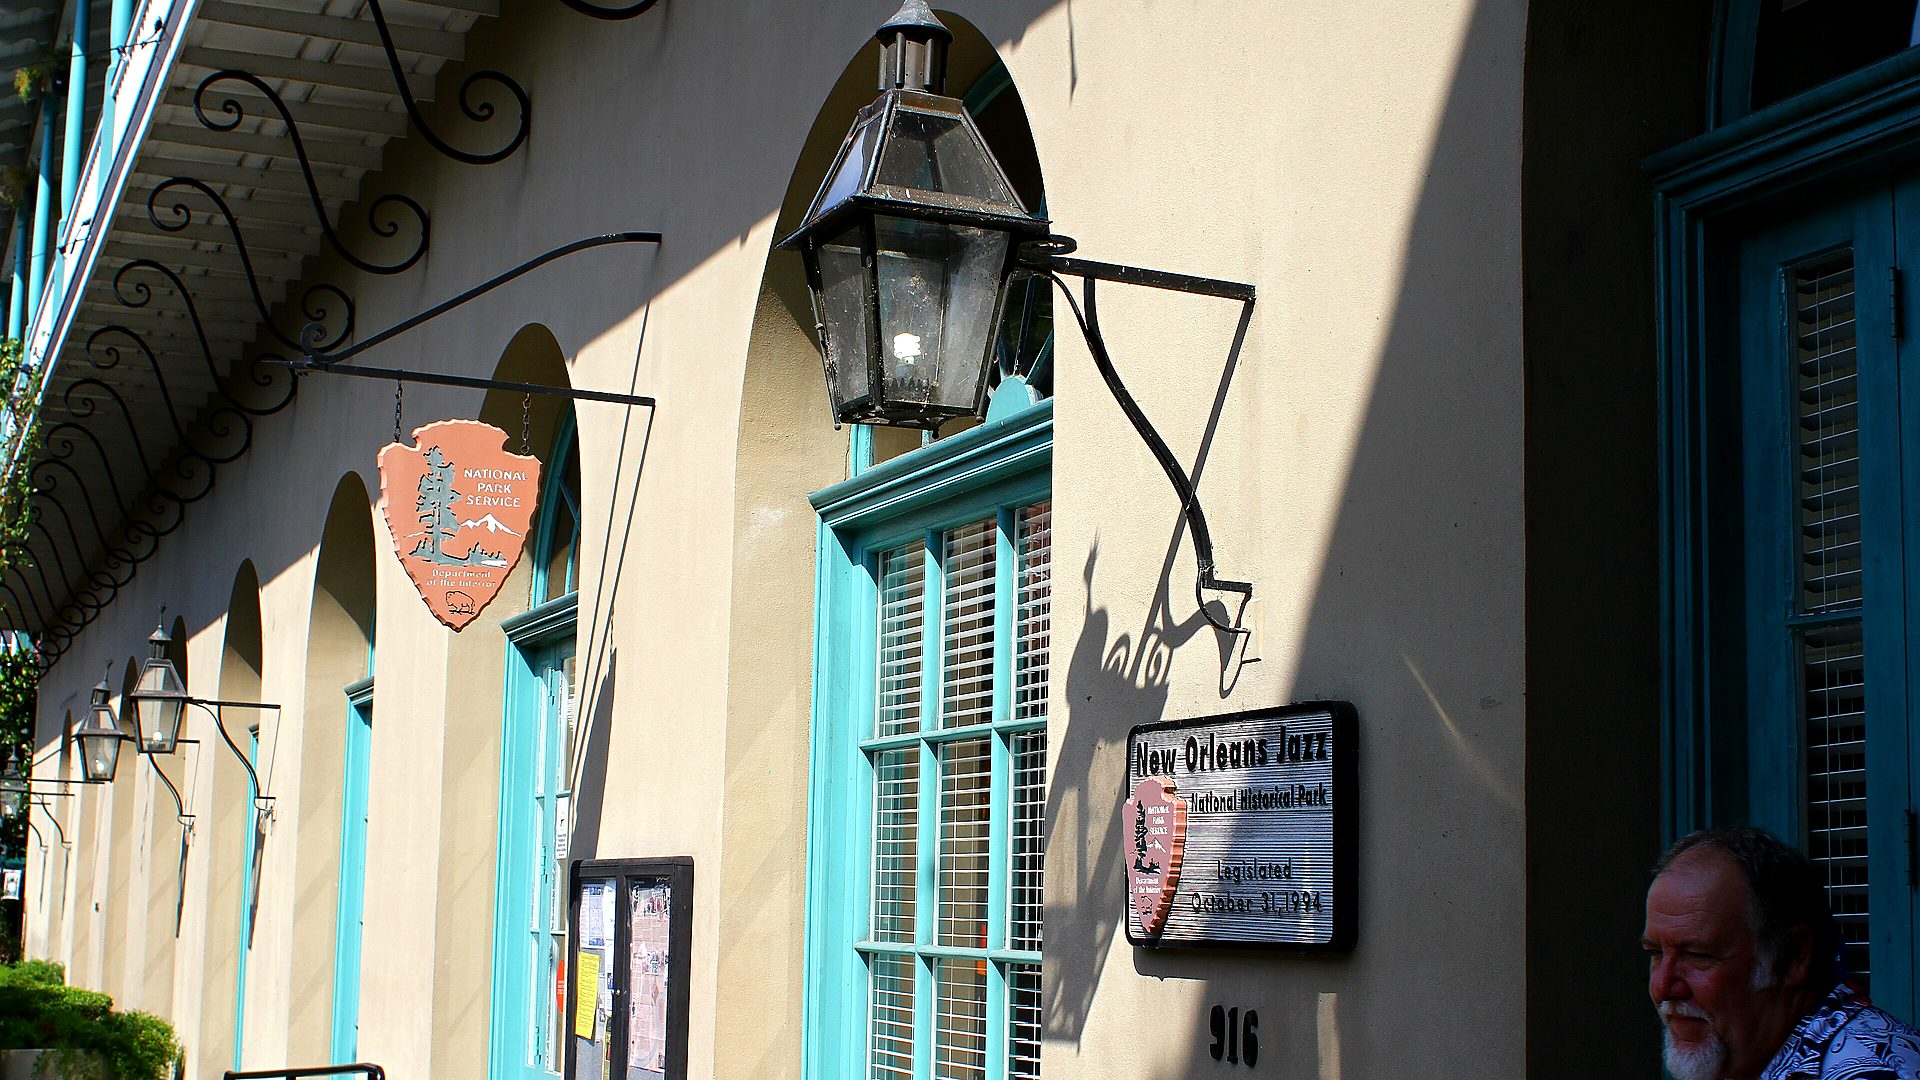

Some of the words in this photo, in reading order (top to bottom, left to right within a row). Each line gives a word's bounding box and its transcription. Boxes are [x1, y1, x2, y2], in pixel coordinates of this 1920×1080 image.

[463, 468, 528, 481] NATIONAL
[477, 482, 513, 494] PARK
[466, 495, 521, 508] SERVICE
[432, 568, 492, 579] Department
[426, 578, 436, 586] of
[439, 579, 456, 587] the
[1136, 741, 1177, 777] New
[1185, 732, 1268, 772] Orleans
[1276, 725, 1328, 763] Jazz
[1191, 789, 1238, 813] National
[1240, 784, 1294, 810] Historical
[1298, 781, 1327, 806] Park
[1217, 857, 1292, 883] Legislated
[1191, 891, 1253, 912] October
[1209, 1004, 1259, 1068] 916
